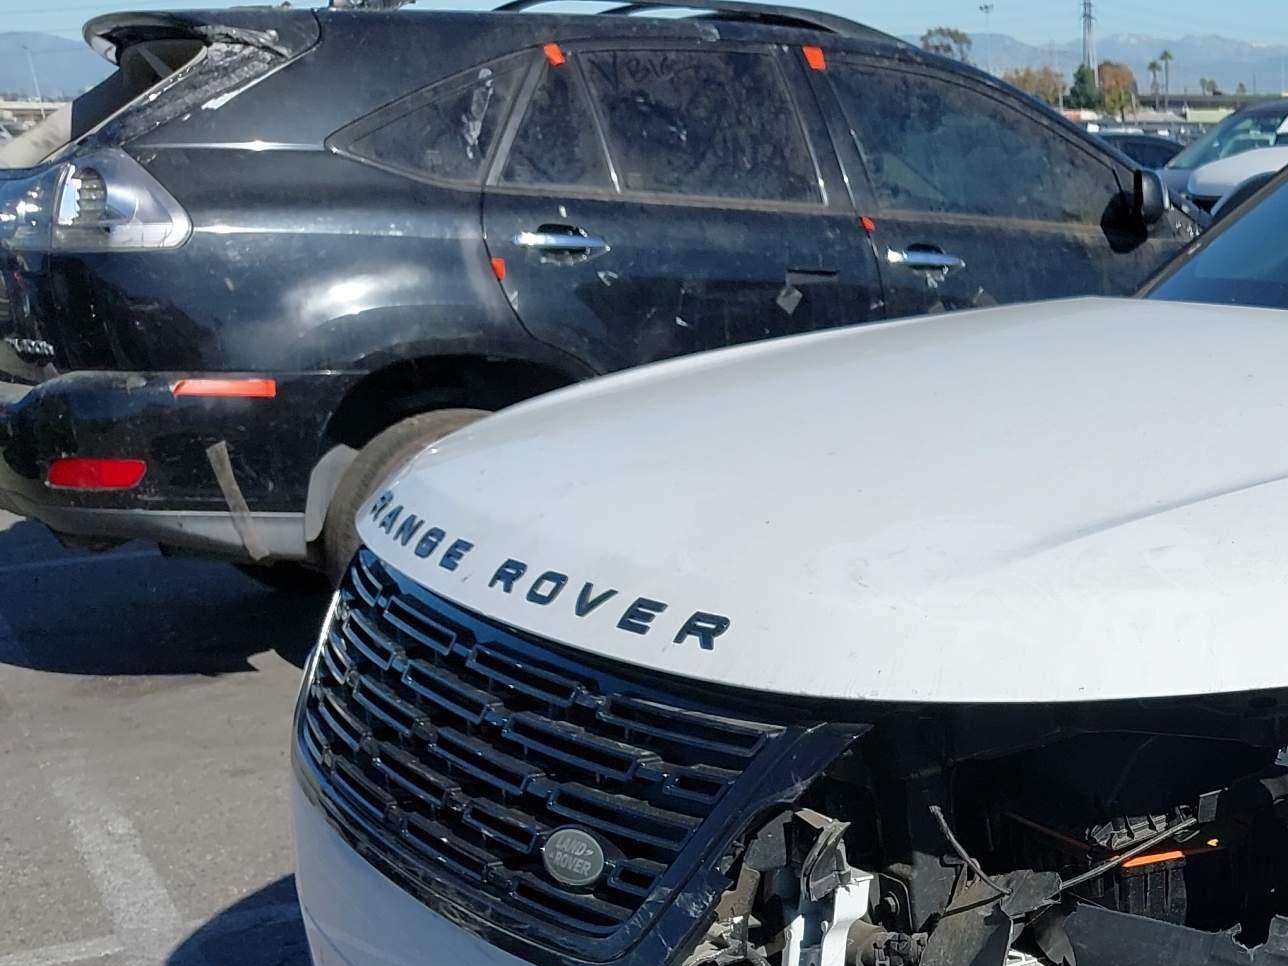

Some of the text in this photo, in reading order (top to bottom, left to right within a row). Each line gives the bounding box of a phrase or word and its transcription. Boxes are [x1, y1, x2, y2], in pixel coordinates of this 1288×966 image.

[369, 490, 731, 651] RANGE ROVER
[554, 835, 588, 856] LAND
[554, 852, 592, 876] ROVER
